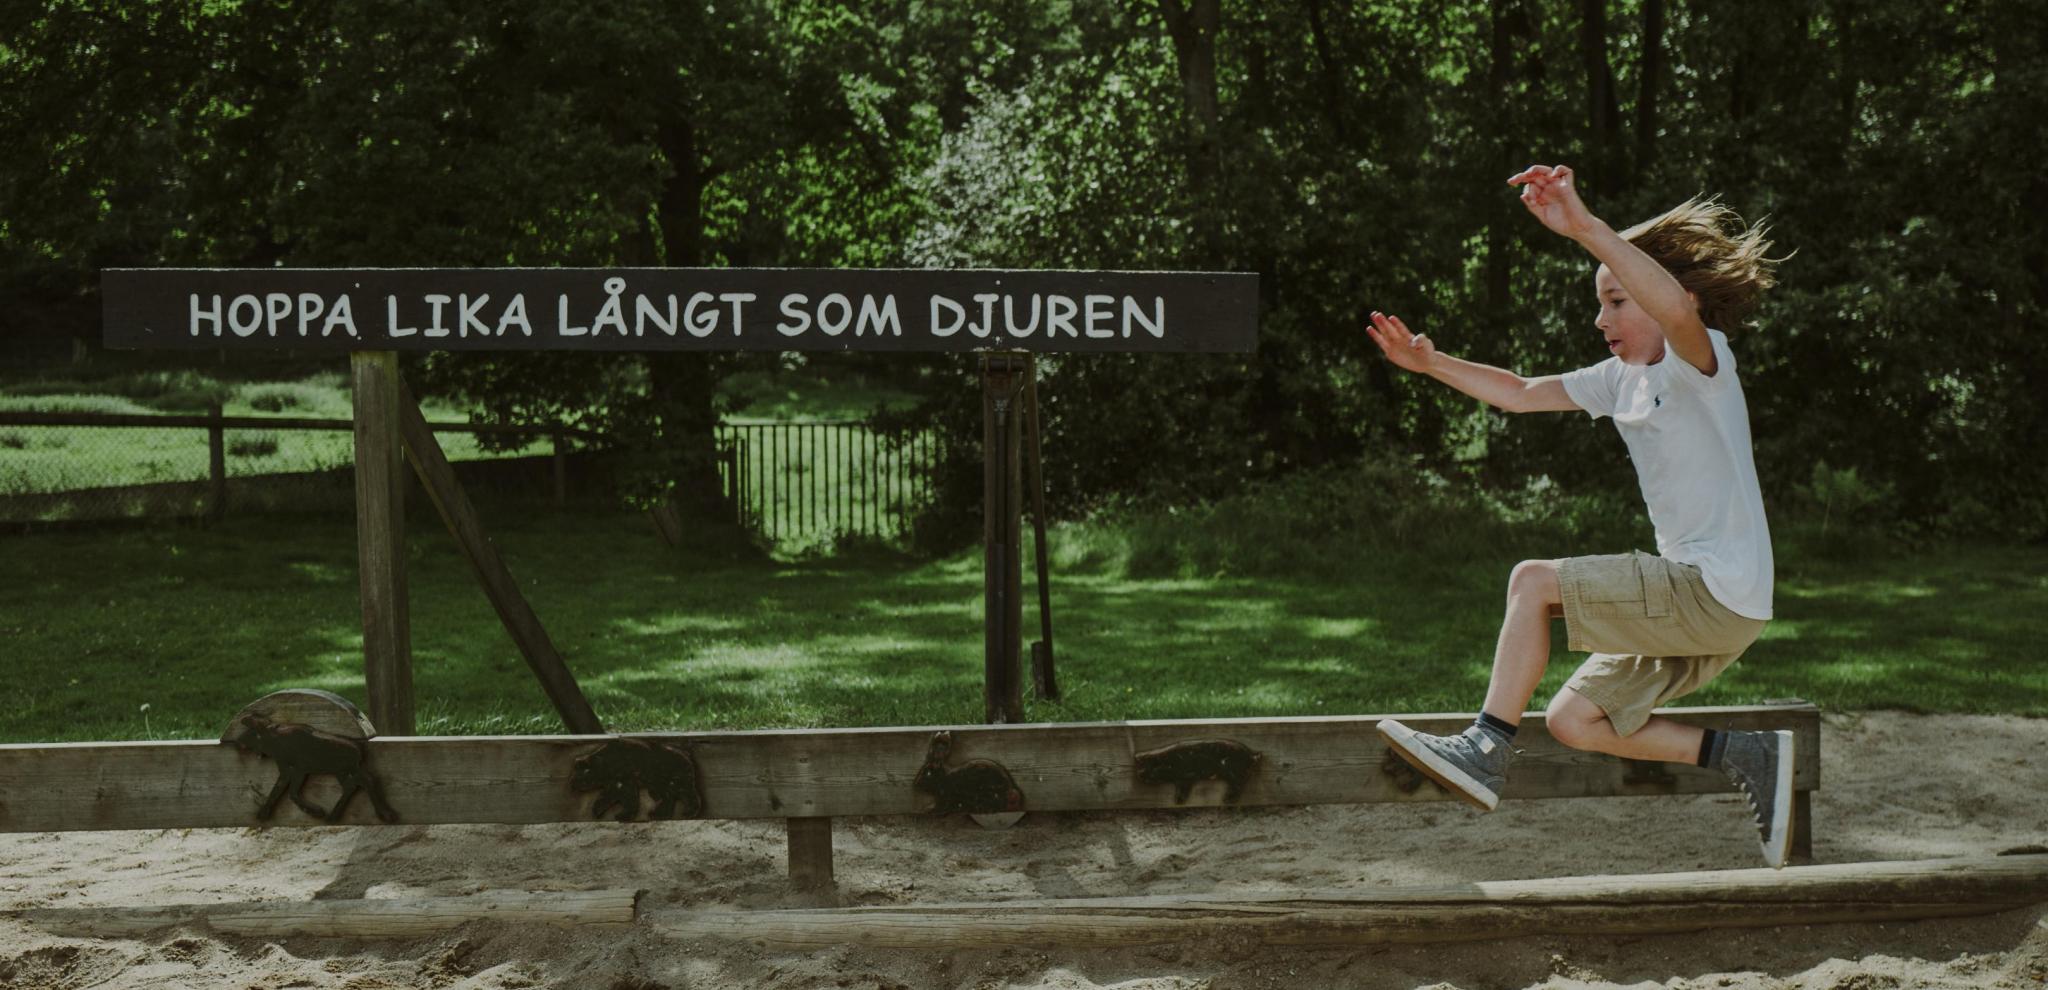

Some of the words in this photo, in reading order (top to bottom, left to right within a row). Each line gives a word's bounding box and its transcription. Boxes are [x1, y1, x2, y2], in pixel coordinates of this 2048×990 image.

[189, 292, 358, 338] HOPPA
[387, 293, 533, 338] LIKA
[557, 276, 757, 338] LÅNGT
[776, 292, 903, 338] SOM
[929, 293, 1166, 339] DJUREN
